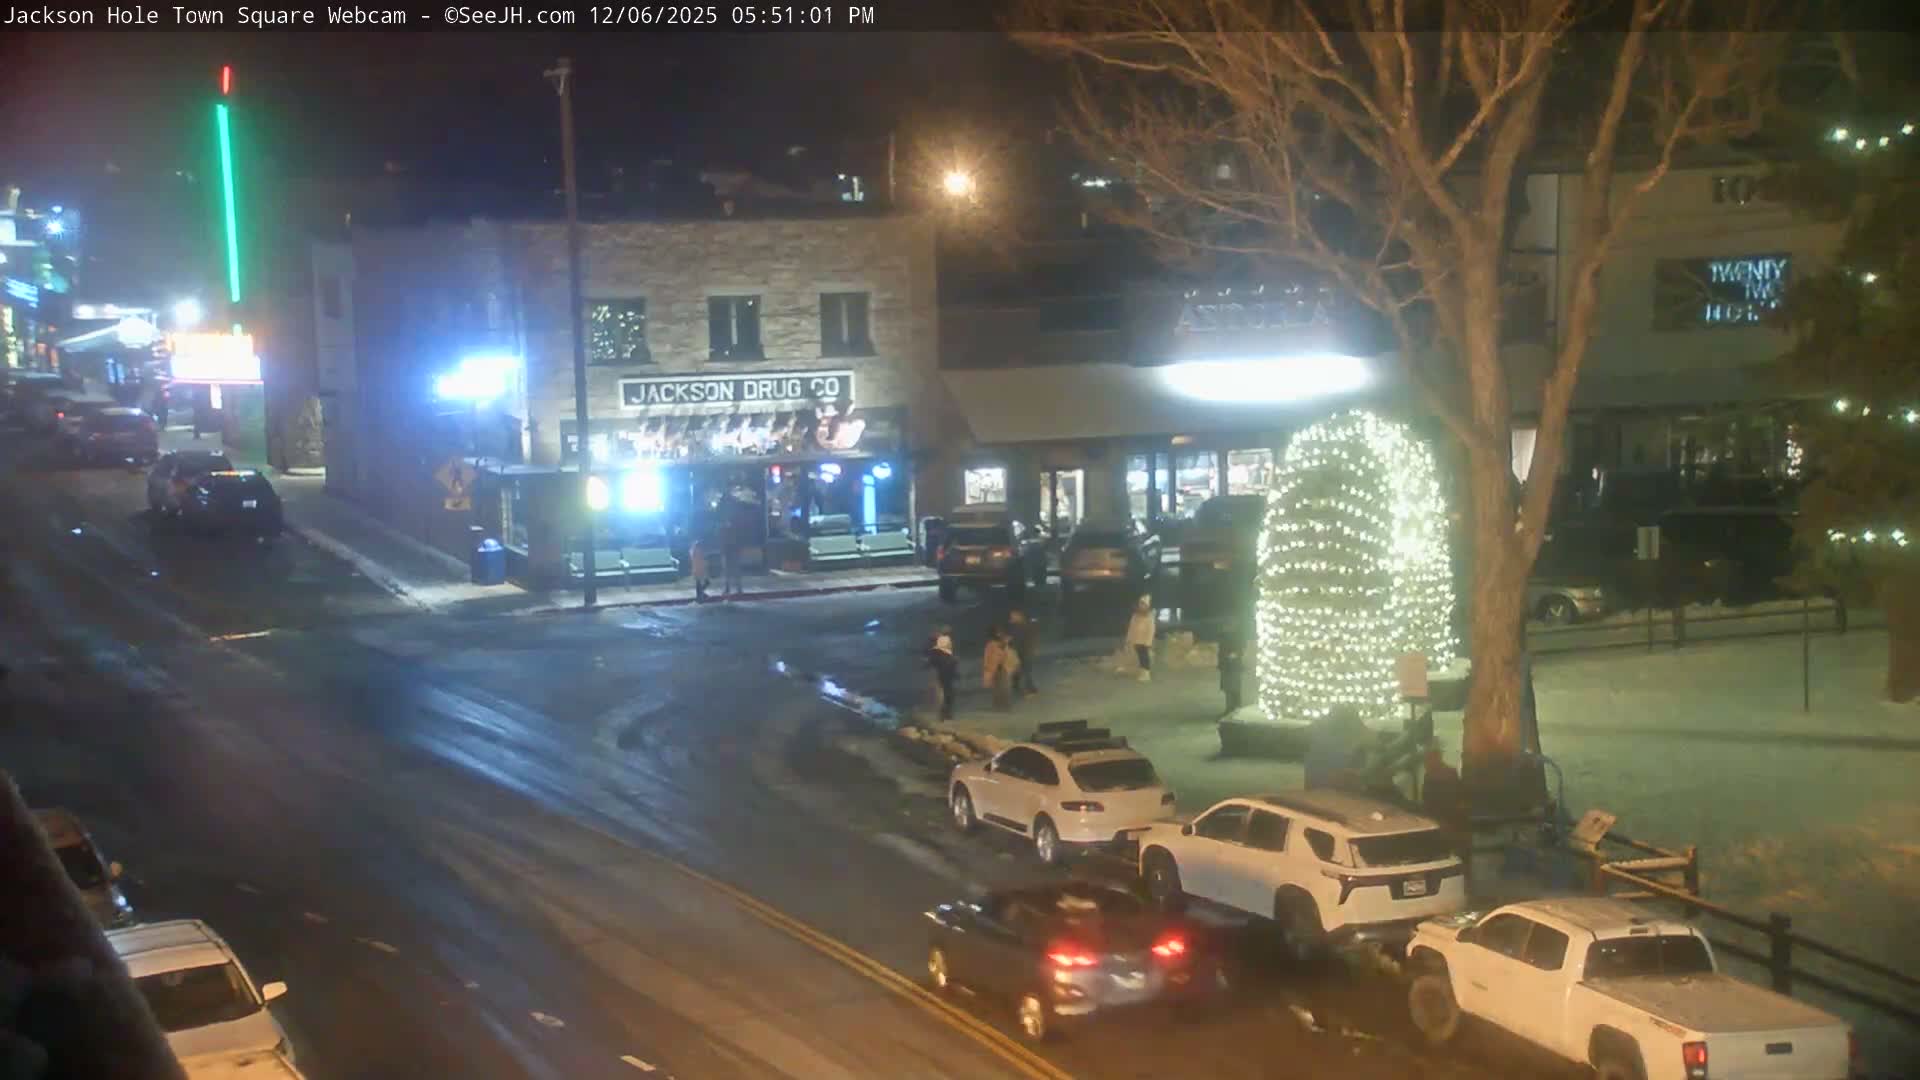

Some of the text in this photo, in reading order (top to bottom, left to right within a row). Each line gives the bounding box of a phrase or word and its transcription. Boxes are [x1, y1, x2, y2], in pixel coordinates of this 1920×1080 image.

[630, 377, 839, 404] JACKSON DRUG CO
